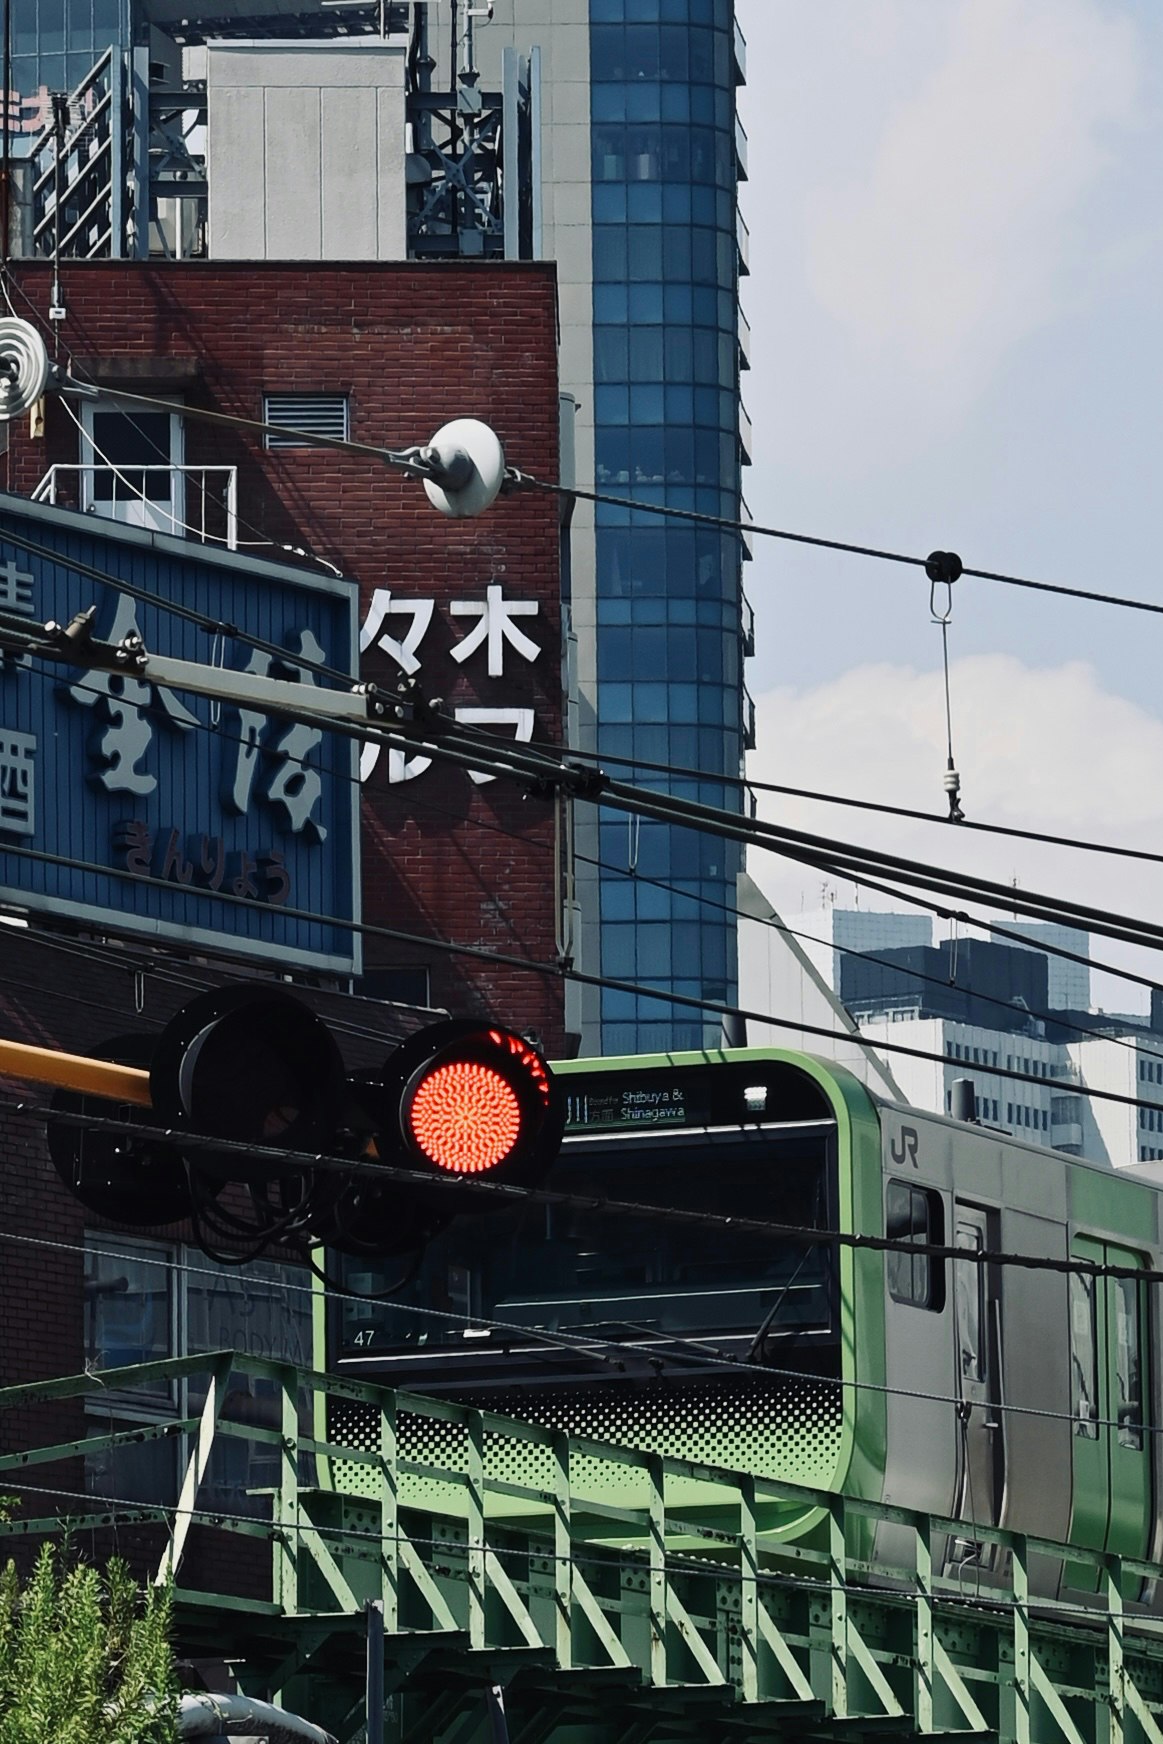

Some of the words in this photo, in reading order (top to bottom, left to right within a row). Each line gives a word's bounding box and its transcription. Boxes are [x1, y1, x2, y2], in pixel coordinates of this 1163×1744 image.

[119, 819, 292, 906] きんりょう
[622, 1091, 670, 1105] Shibuya
[621, 1106, 685, 1122] Shinagawa
[890, 1126, 919, 1169] JR
[354, 1330, 376, 1347] 47
